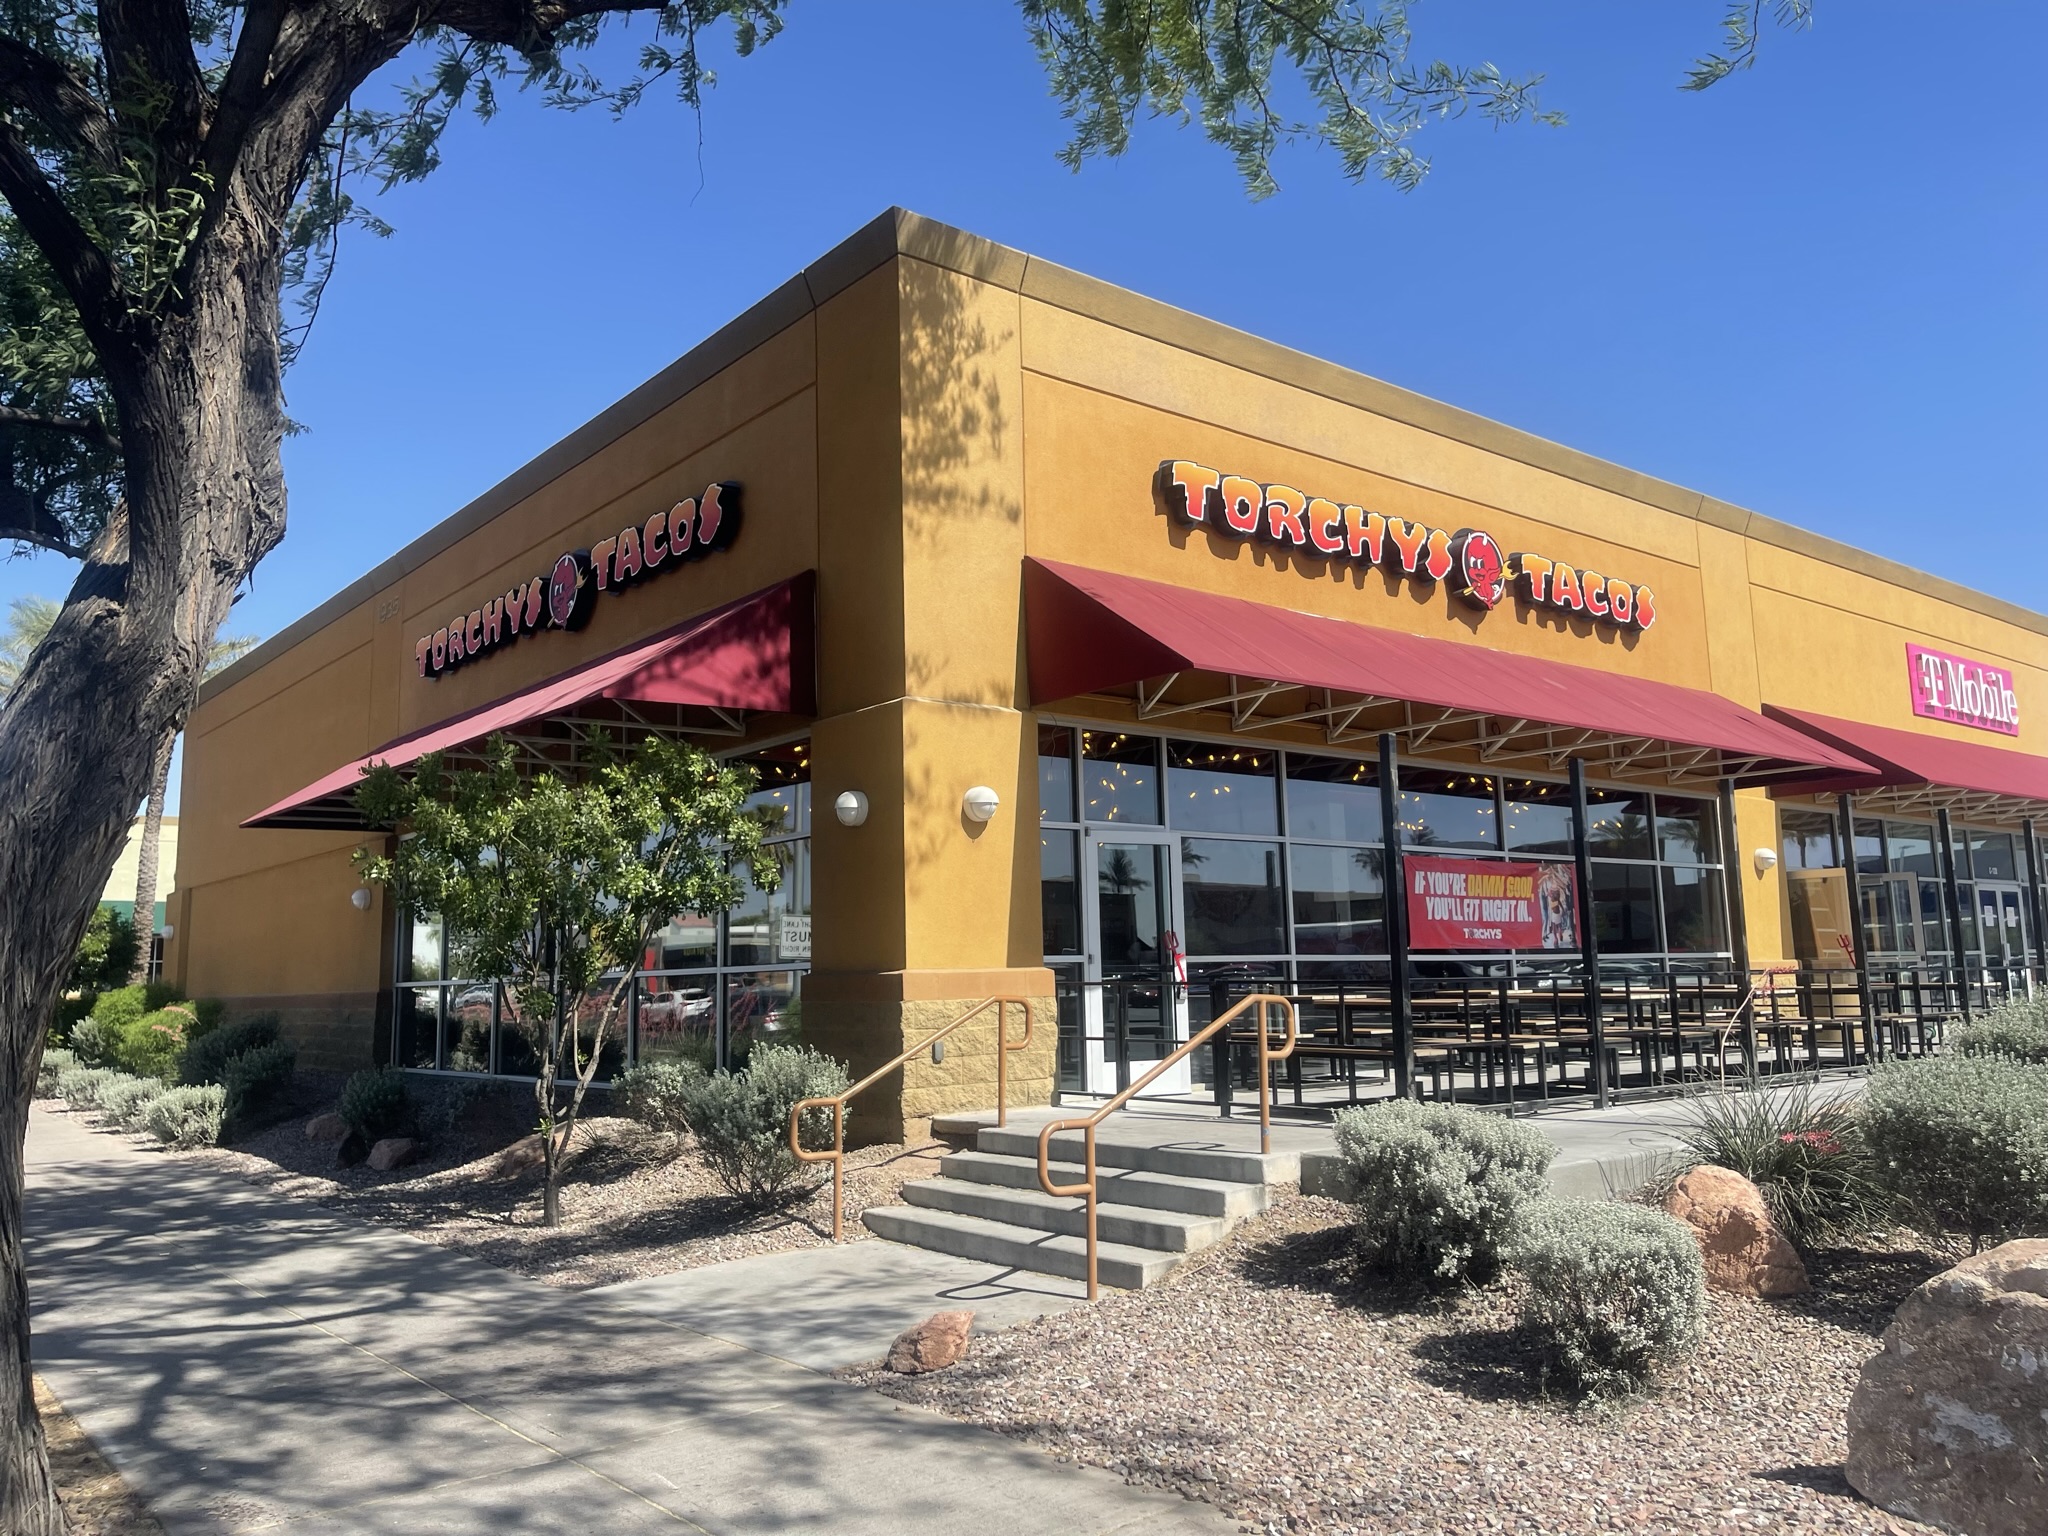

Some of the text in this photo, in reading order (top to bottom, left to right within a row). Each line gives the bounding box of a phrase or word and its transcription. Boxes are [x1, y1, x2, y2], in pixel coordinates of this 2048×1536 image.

[415, 483, 722, 678] TORCHYS TACOS
[1172, 460, 1656, 630] TORCHYS TACOS
[1415, 870, 1535, 903] IF YOU'RE DAMN GOOD,
[1425, 896, 1533, 922] YOU'LL FIT RIGHT IN.
